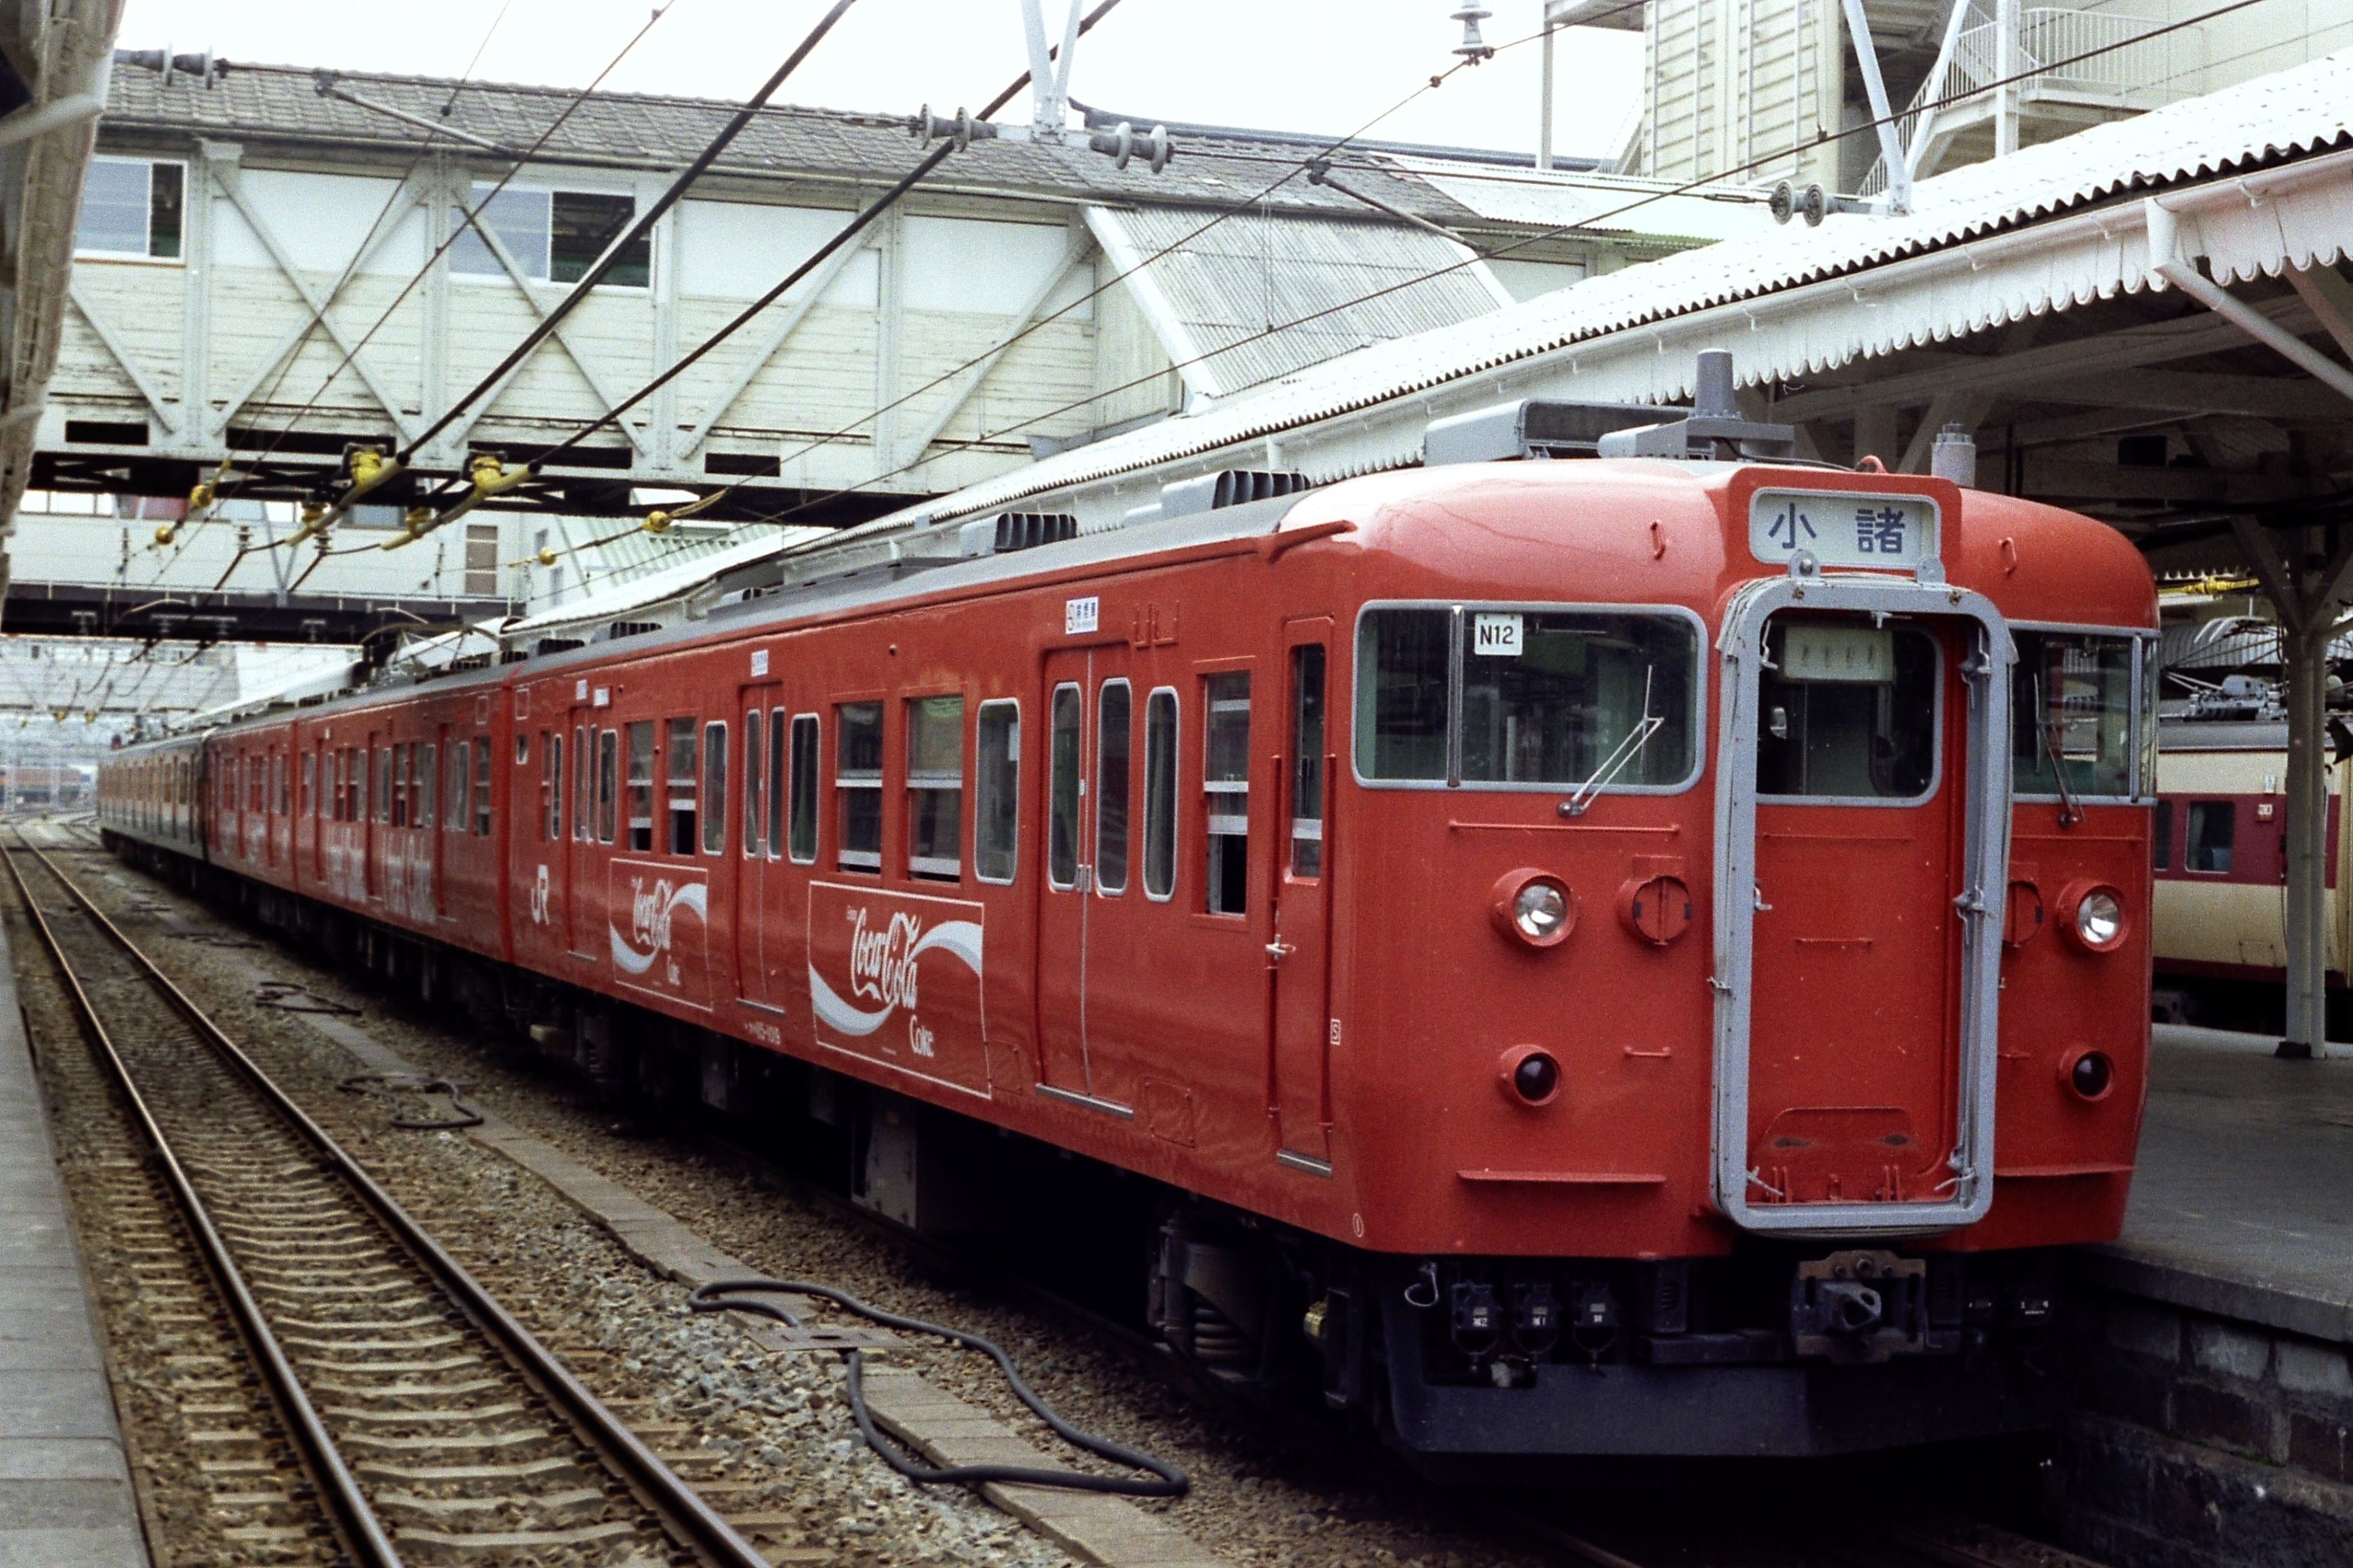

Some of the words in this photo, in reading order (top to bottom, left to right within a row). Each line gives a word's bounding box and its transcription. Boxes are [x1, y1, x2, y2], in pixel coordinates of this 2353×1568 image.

[1768, 501, 1905, 554] 小諸
[1480, 624, 1514, 645] N12
[531, 864, 549, 926] JR
[851, 907, 921, 1010] Coca-Cola
[909, 1014, 934, 1057] Coke
